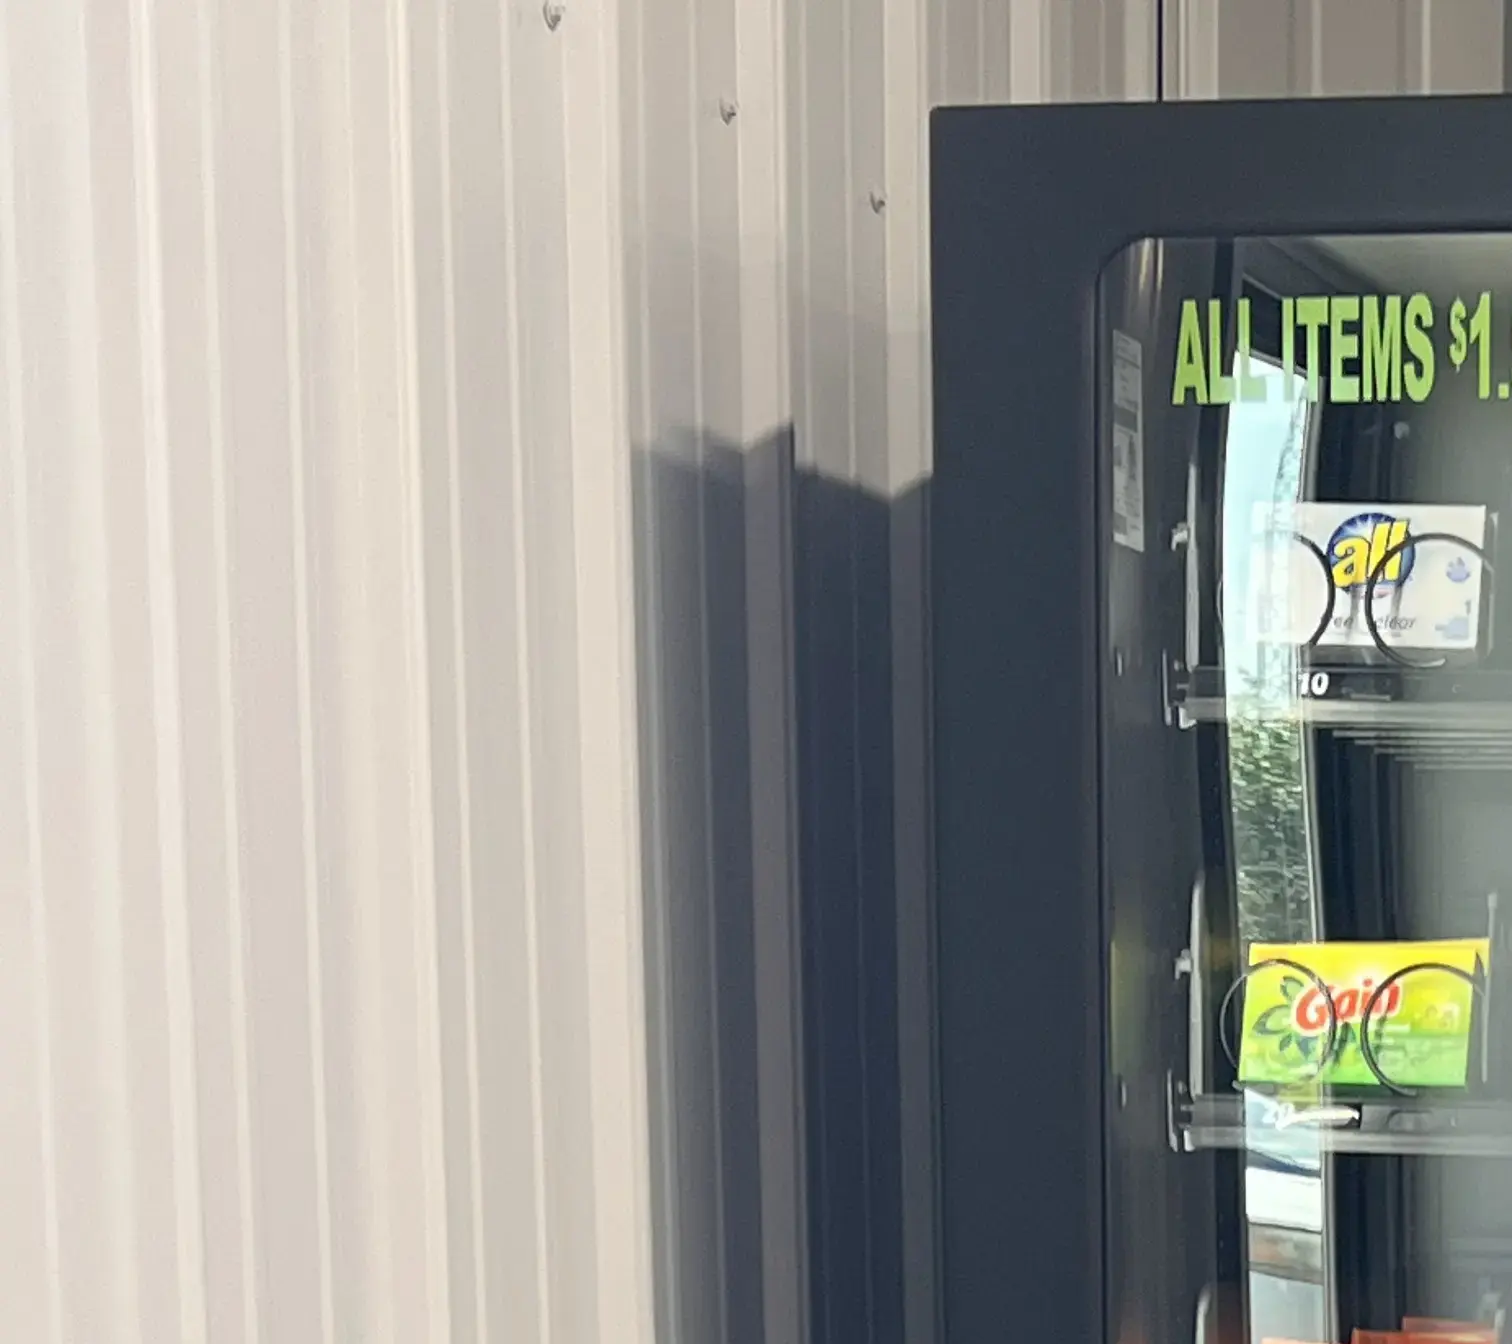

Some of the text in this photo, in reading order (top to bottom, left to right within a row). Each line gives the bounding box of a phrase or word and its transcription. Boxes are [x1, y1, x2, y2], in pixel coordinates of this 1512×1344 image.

[1171, 297, 1267, 404] ALL
[1282, 293, 1435, 403] ITEMS
[1332, 518, 1411, 588] all
[1297, 673, 1330, 695] 10
[1295, 978, 1401, 1031] Gain
